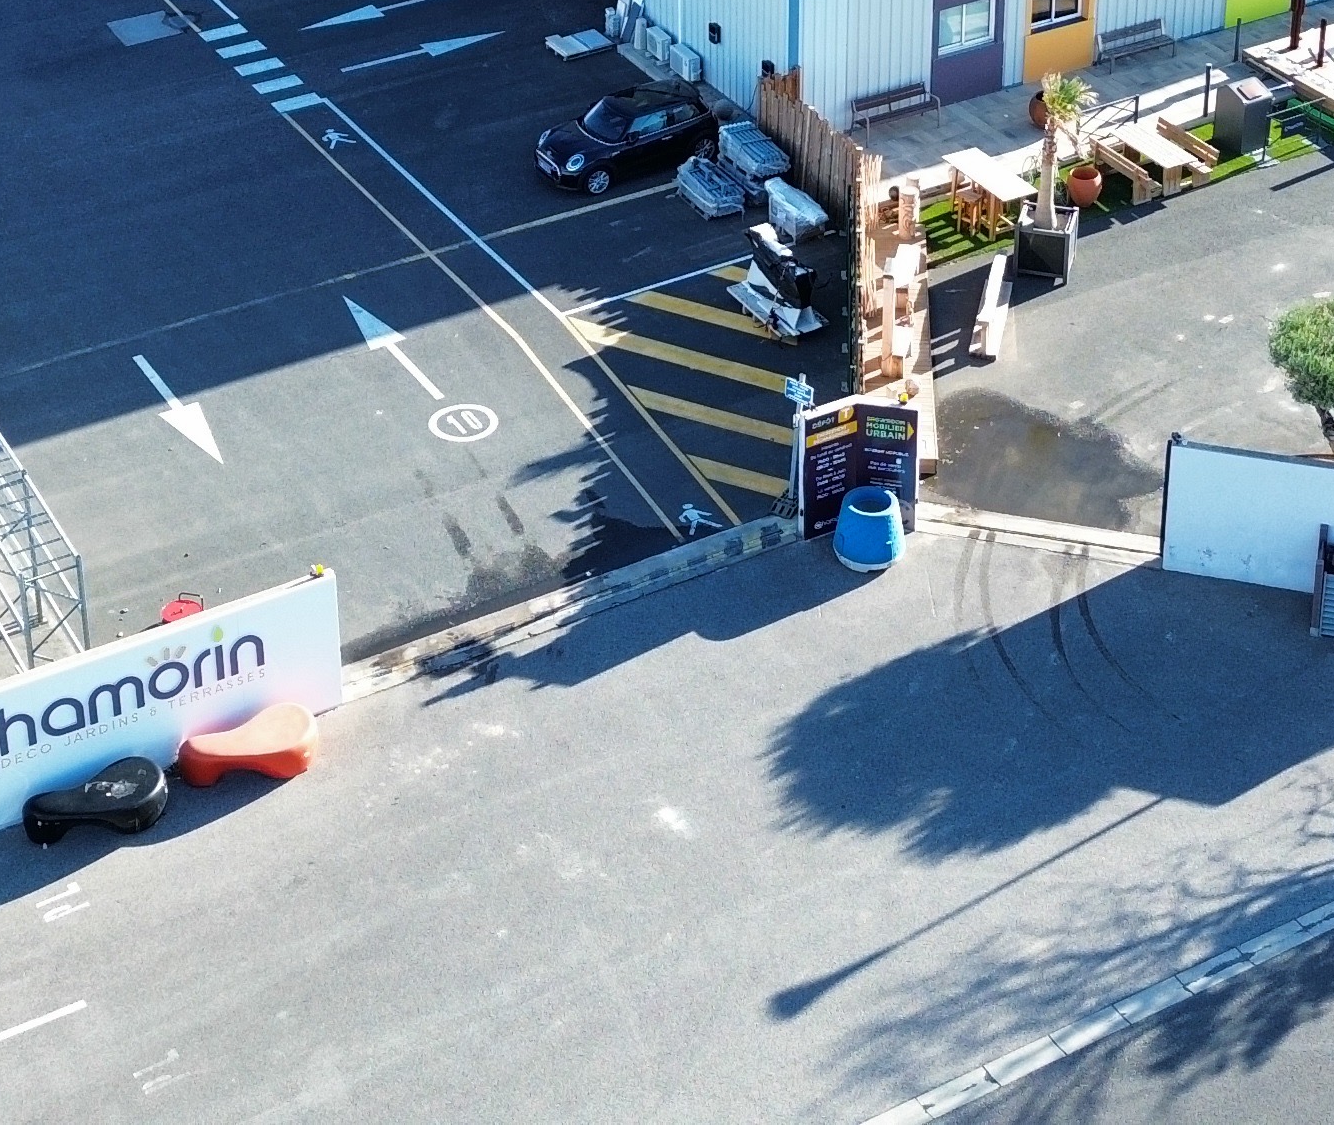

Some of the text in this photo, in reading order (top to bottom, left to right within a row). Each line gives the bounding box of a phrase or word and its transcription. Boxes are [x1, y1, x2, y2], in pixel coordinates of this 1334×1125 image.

[447, 410, 483, 434] 10
[866, 428, 906, 441] URBAIN
[0, 743, 53, 770] DECO
[64, 712, 140, 747] JARDINS
[167, 669, 267, 710] TERRASSES
[36, 881, 91, 923] PL
